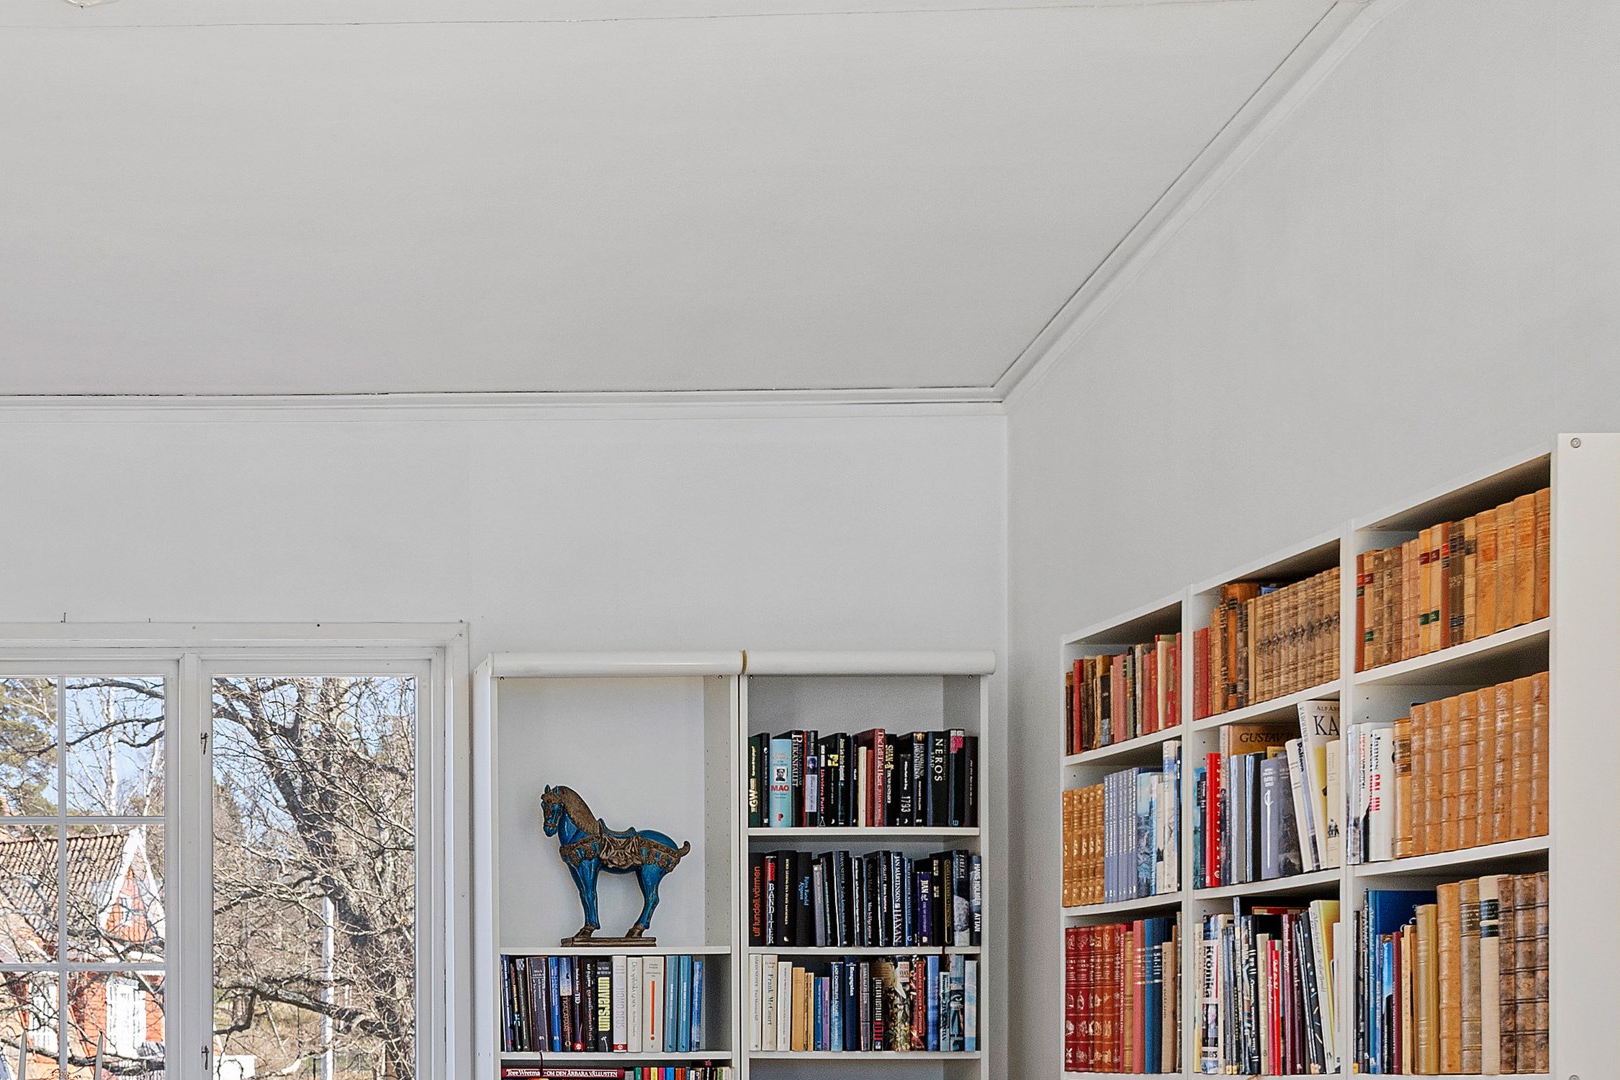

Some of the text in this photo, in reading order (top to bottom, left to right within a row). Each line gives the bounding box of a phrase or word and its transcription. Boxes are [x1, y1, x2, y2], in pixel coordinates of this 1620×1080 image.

[1240, 732, 1281, 743] GUSTAV
[935, 739, 944, 781] NEROS
[900, 796, 911, 812] 1793
[752, 866, 760, 936] ulf värmen
[894, 856, 902, 942] JAN MÅRTENSON HÄXAN
[1205, 946, 1214, 998] Krönika
[598, 977, 611, 1031] universum
[616, 988, 625, 1028] HOMO DEUS
[506, 1068, 519, 1077] Tore
[557, 1068, 566, 1077] DEN
